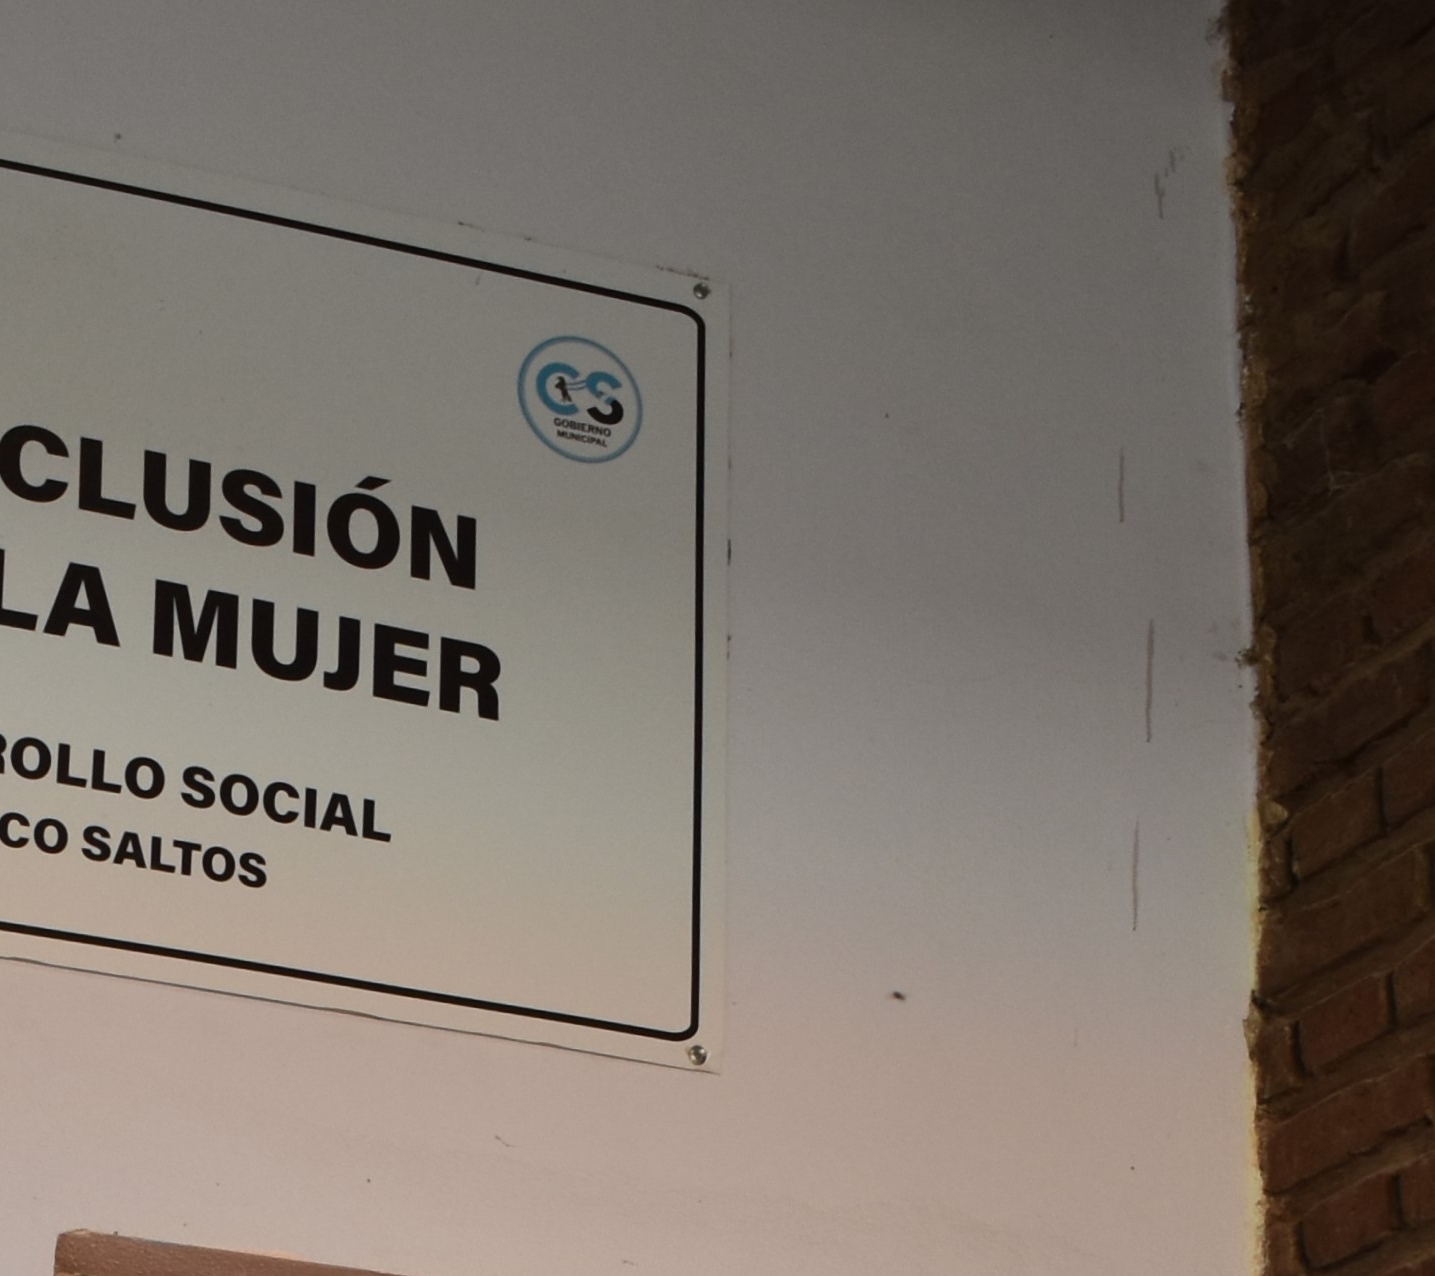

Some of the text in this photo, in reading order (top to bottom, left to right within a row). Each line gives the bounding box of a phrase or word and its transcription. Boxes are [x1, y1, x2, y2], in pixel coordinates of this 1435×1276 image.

[554, 417, 611, 437] GOBIERNO
[557, 430, 607, 447] MUNICIPAL
[152, 578, 502, 722] MUJER
[181, 765, 393, 844] SOCIAL
[81, 825, 268, 890] SALTOS
